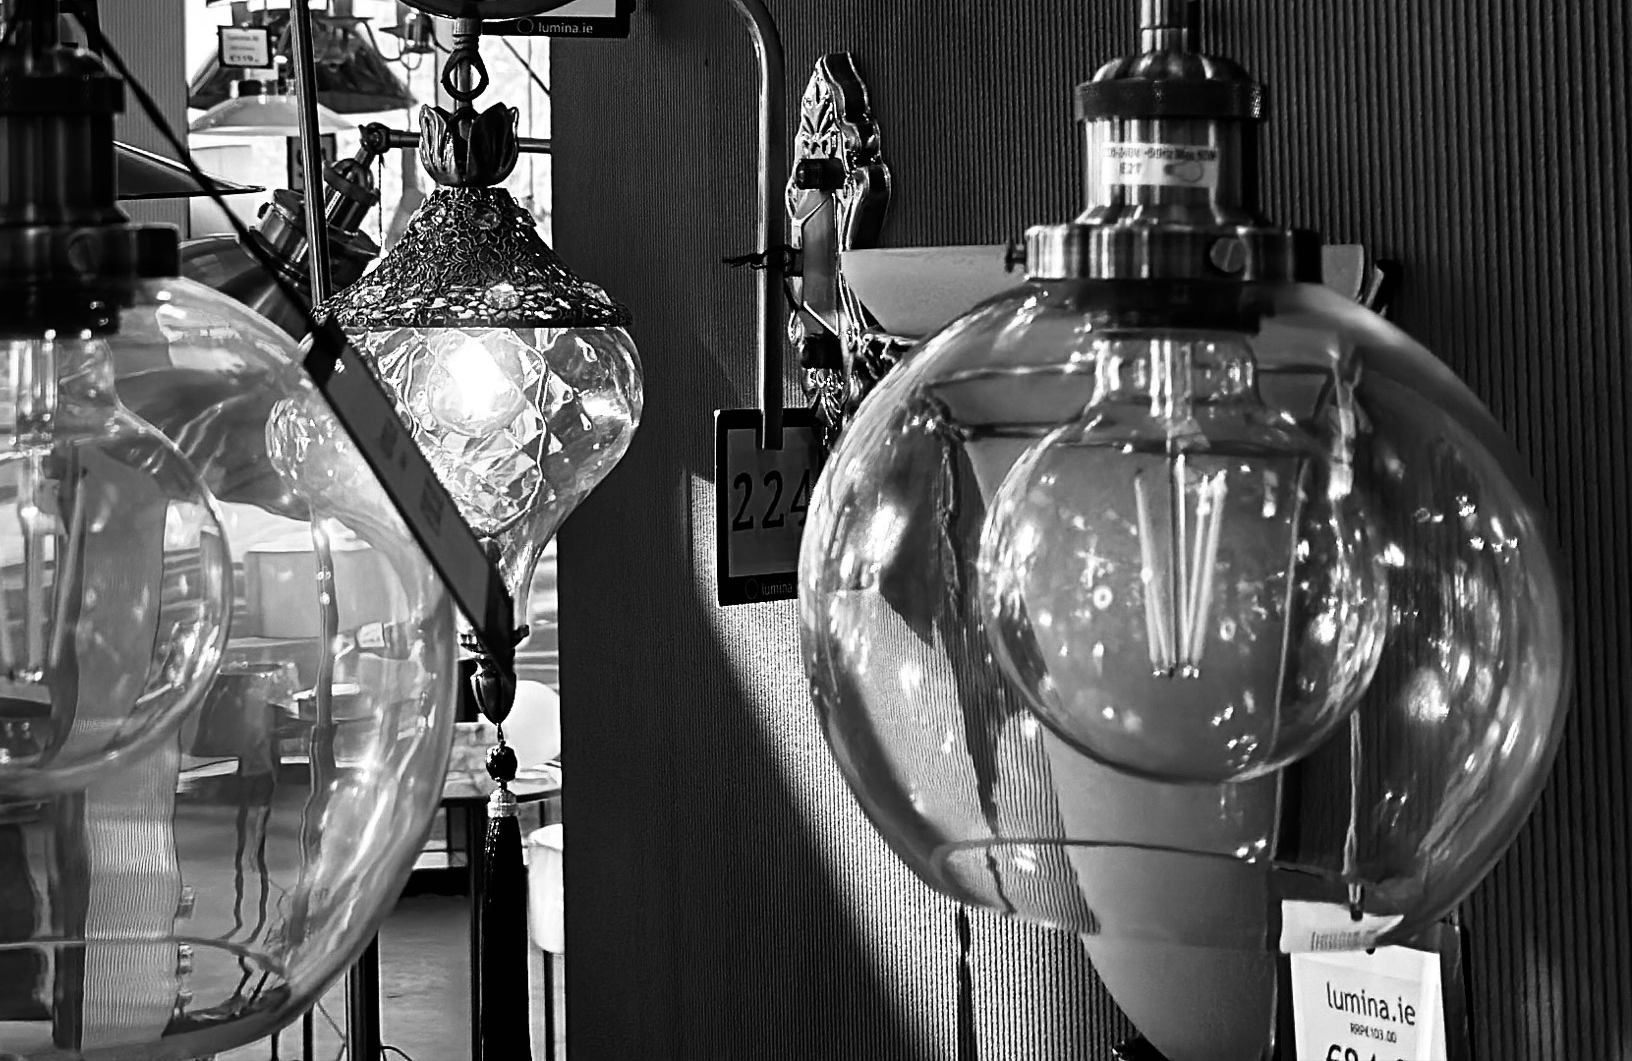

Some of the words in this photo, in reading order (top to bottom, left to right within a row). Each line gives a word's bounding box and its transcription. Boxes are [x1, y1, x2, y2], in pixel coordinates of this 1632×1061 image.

[537, 21, 594, 34] lumina.ie
[732, 468, 811, 532] 224
[761, 581, 793, 596] lumina
[1326, 980, 1416, 1026] lumina.ie
